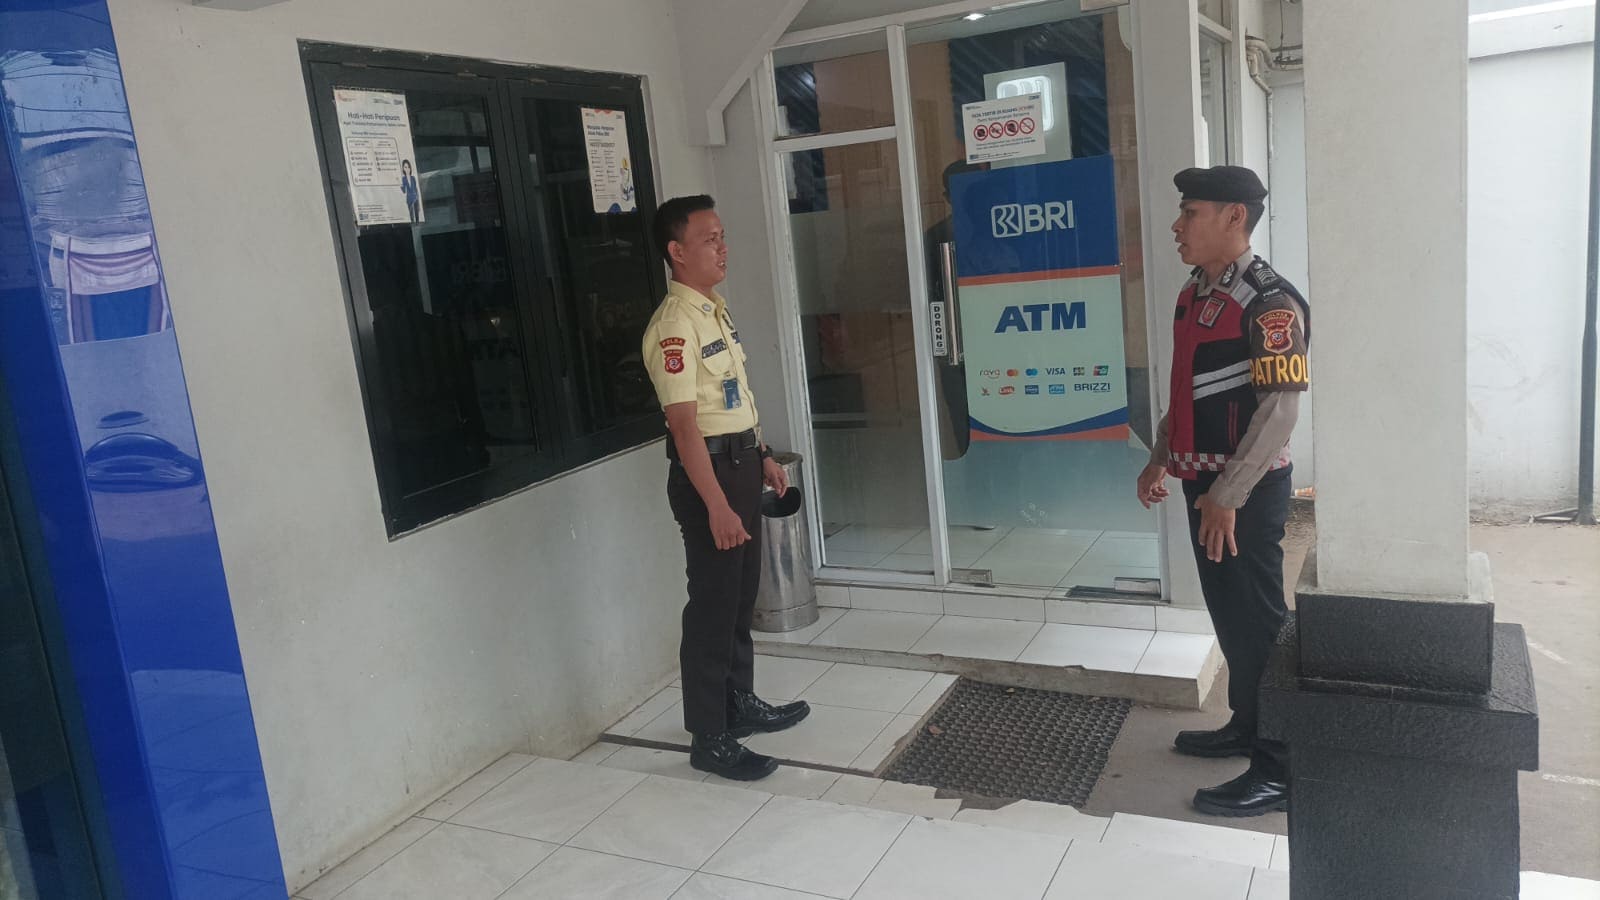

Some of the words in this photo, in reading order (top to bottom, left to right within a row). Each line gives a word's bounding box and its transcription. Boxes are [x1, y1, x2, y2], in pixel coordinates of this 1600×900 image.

[1024, 200, 1075, 233] BRI
[934, 305, 943, 347] DORONG
[994, 301, 1087, 334] ATM
[1046, 367, 1066, 376] VISA
[1074, 383, 1111, 391] BRIZZI
